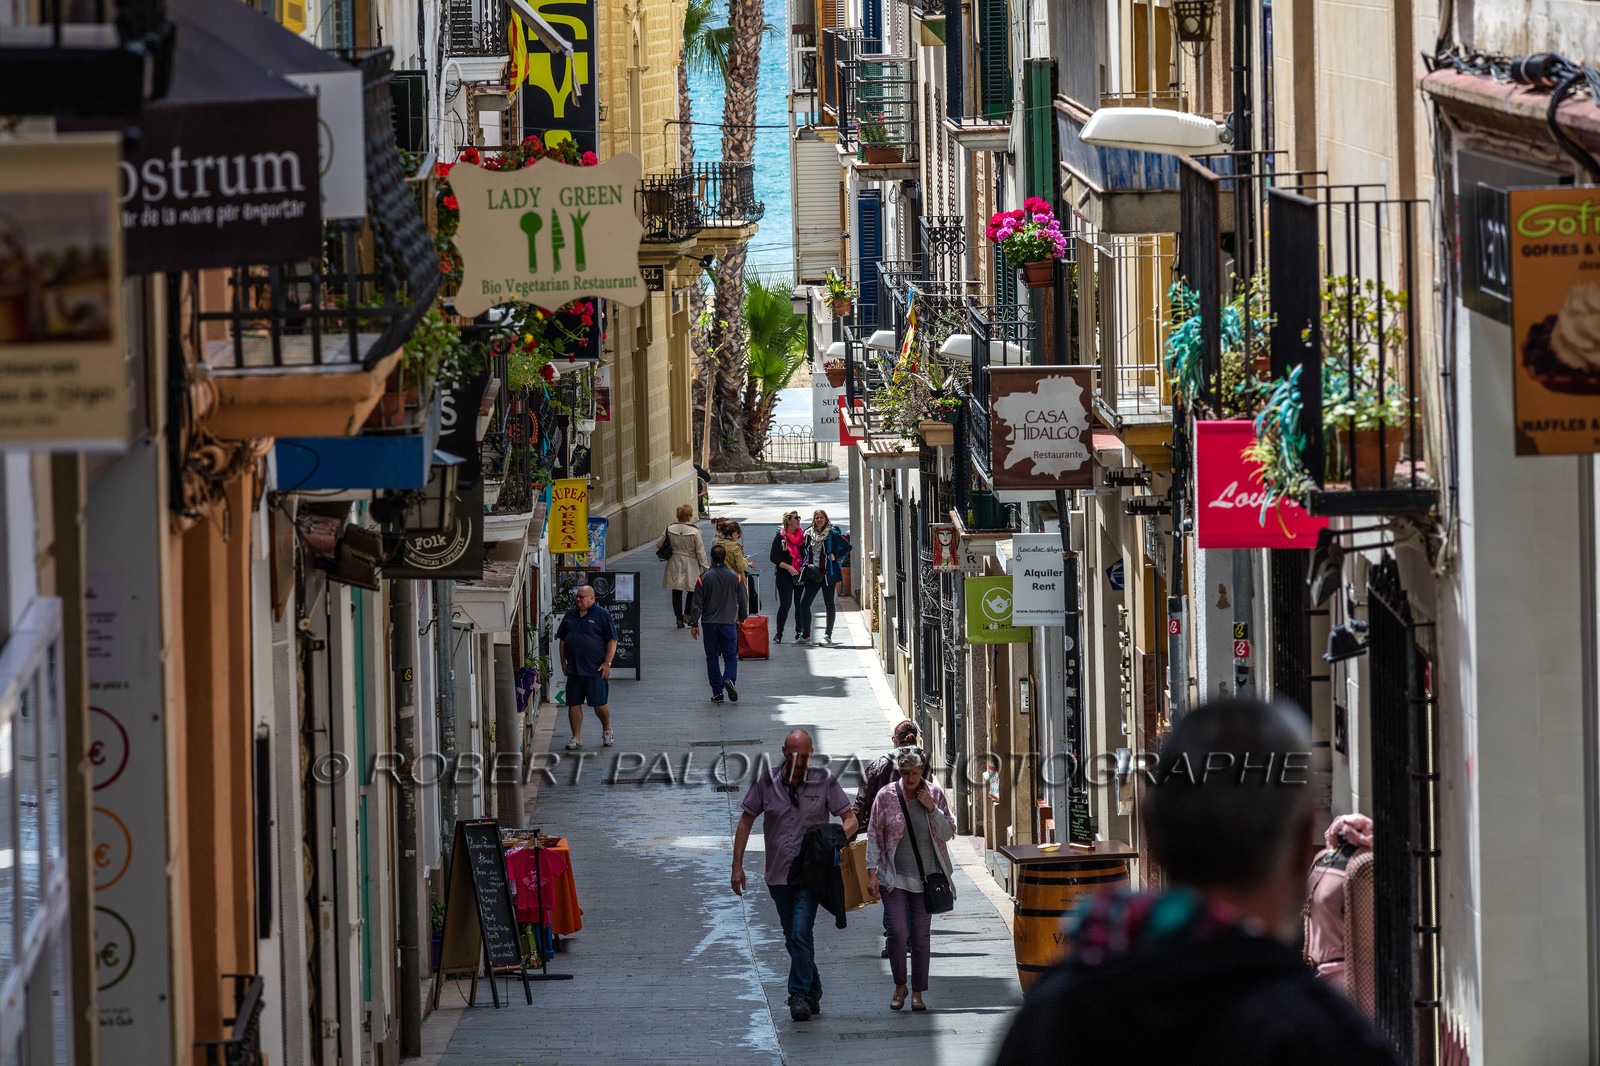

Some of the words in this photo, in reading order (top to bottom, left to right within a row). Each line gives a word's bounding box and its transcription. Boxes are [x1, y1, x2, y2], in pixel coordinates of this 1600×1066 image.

[487, 187, 541, 210] LADY
[559, 184, 623, 207] GREEN
[1521, 243, 1579, 258] GOFRES
[481, 279, 502, 295] Bio
[505, 277, 570, 297] Vegetarian
[573, 275, 638, 291] Restaurant
[820, 417, 839, 425] LOU
[1025, 410, 1068, 423] CASA
[1013, 423, 1079, 440] HIDALGO
[1033, 450, 1084, 459] Restaurante
[557, 504, 578, 549] MERCAT
[415, 534, 447, 550] Folk
[1024, 569, 1064, 578] Alquiler
[1032, 582, 1056, 591] Rent
